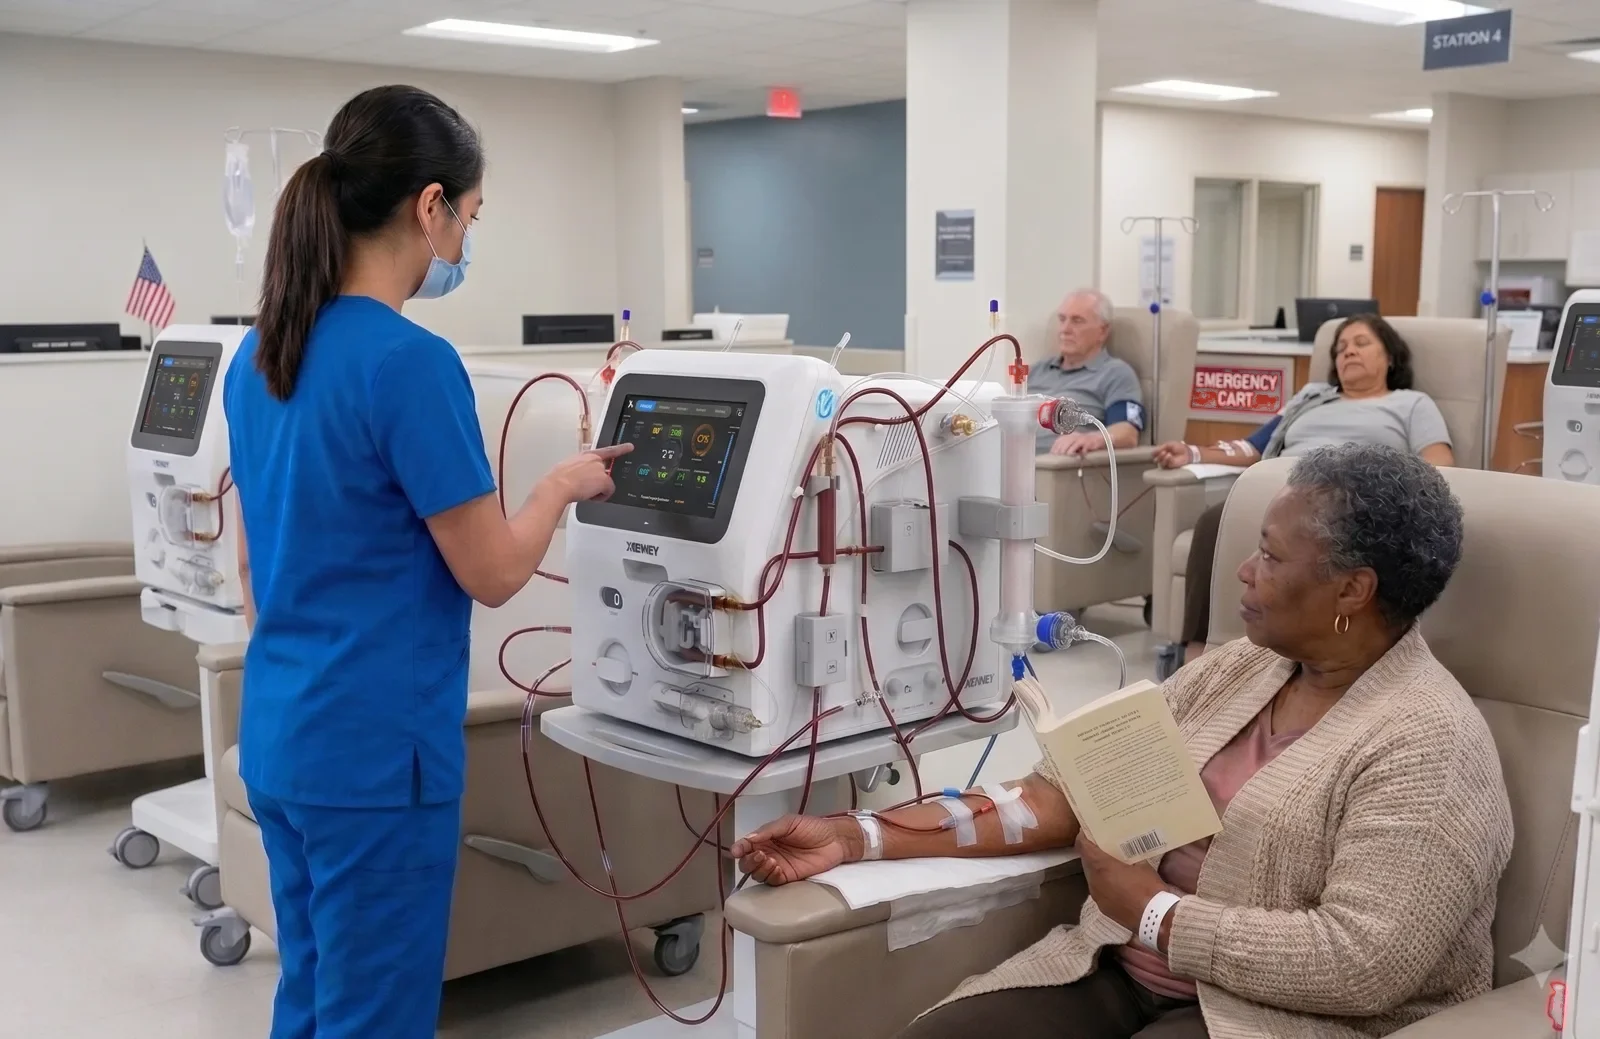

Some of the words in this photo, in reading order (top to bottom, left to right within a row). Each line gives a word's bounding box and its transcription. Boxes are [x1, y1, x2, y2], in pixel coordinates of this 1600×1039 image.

[1432, 29, 1490, 50] STATION
[1492, 28, 1501, 42] 4
[1195, 372, 1278, 391] EMERGENCY
[1217, 390, 1254, 407] CART
